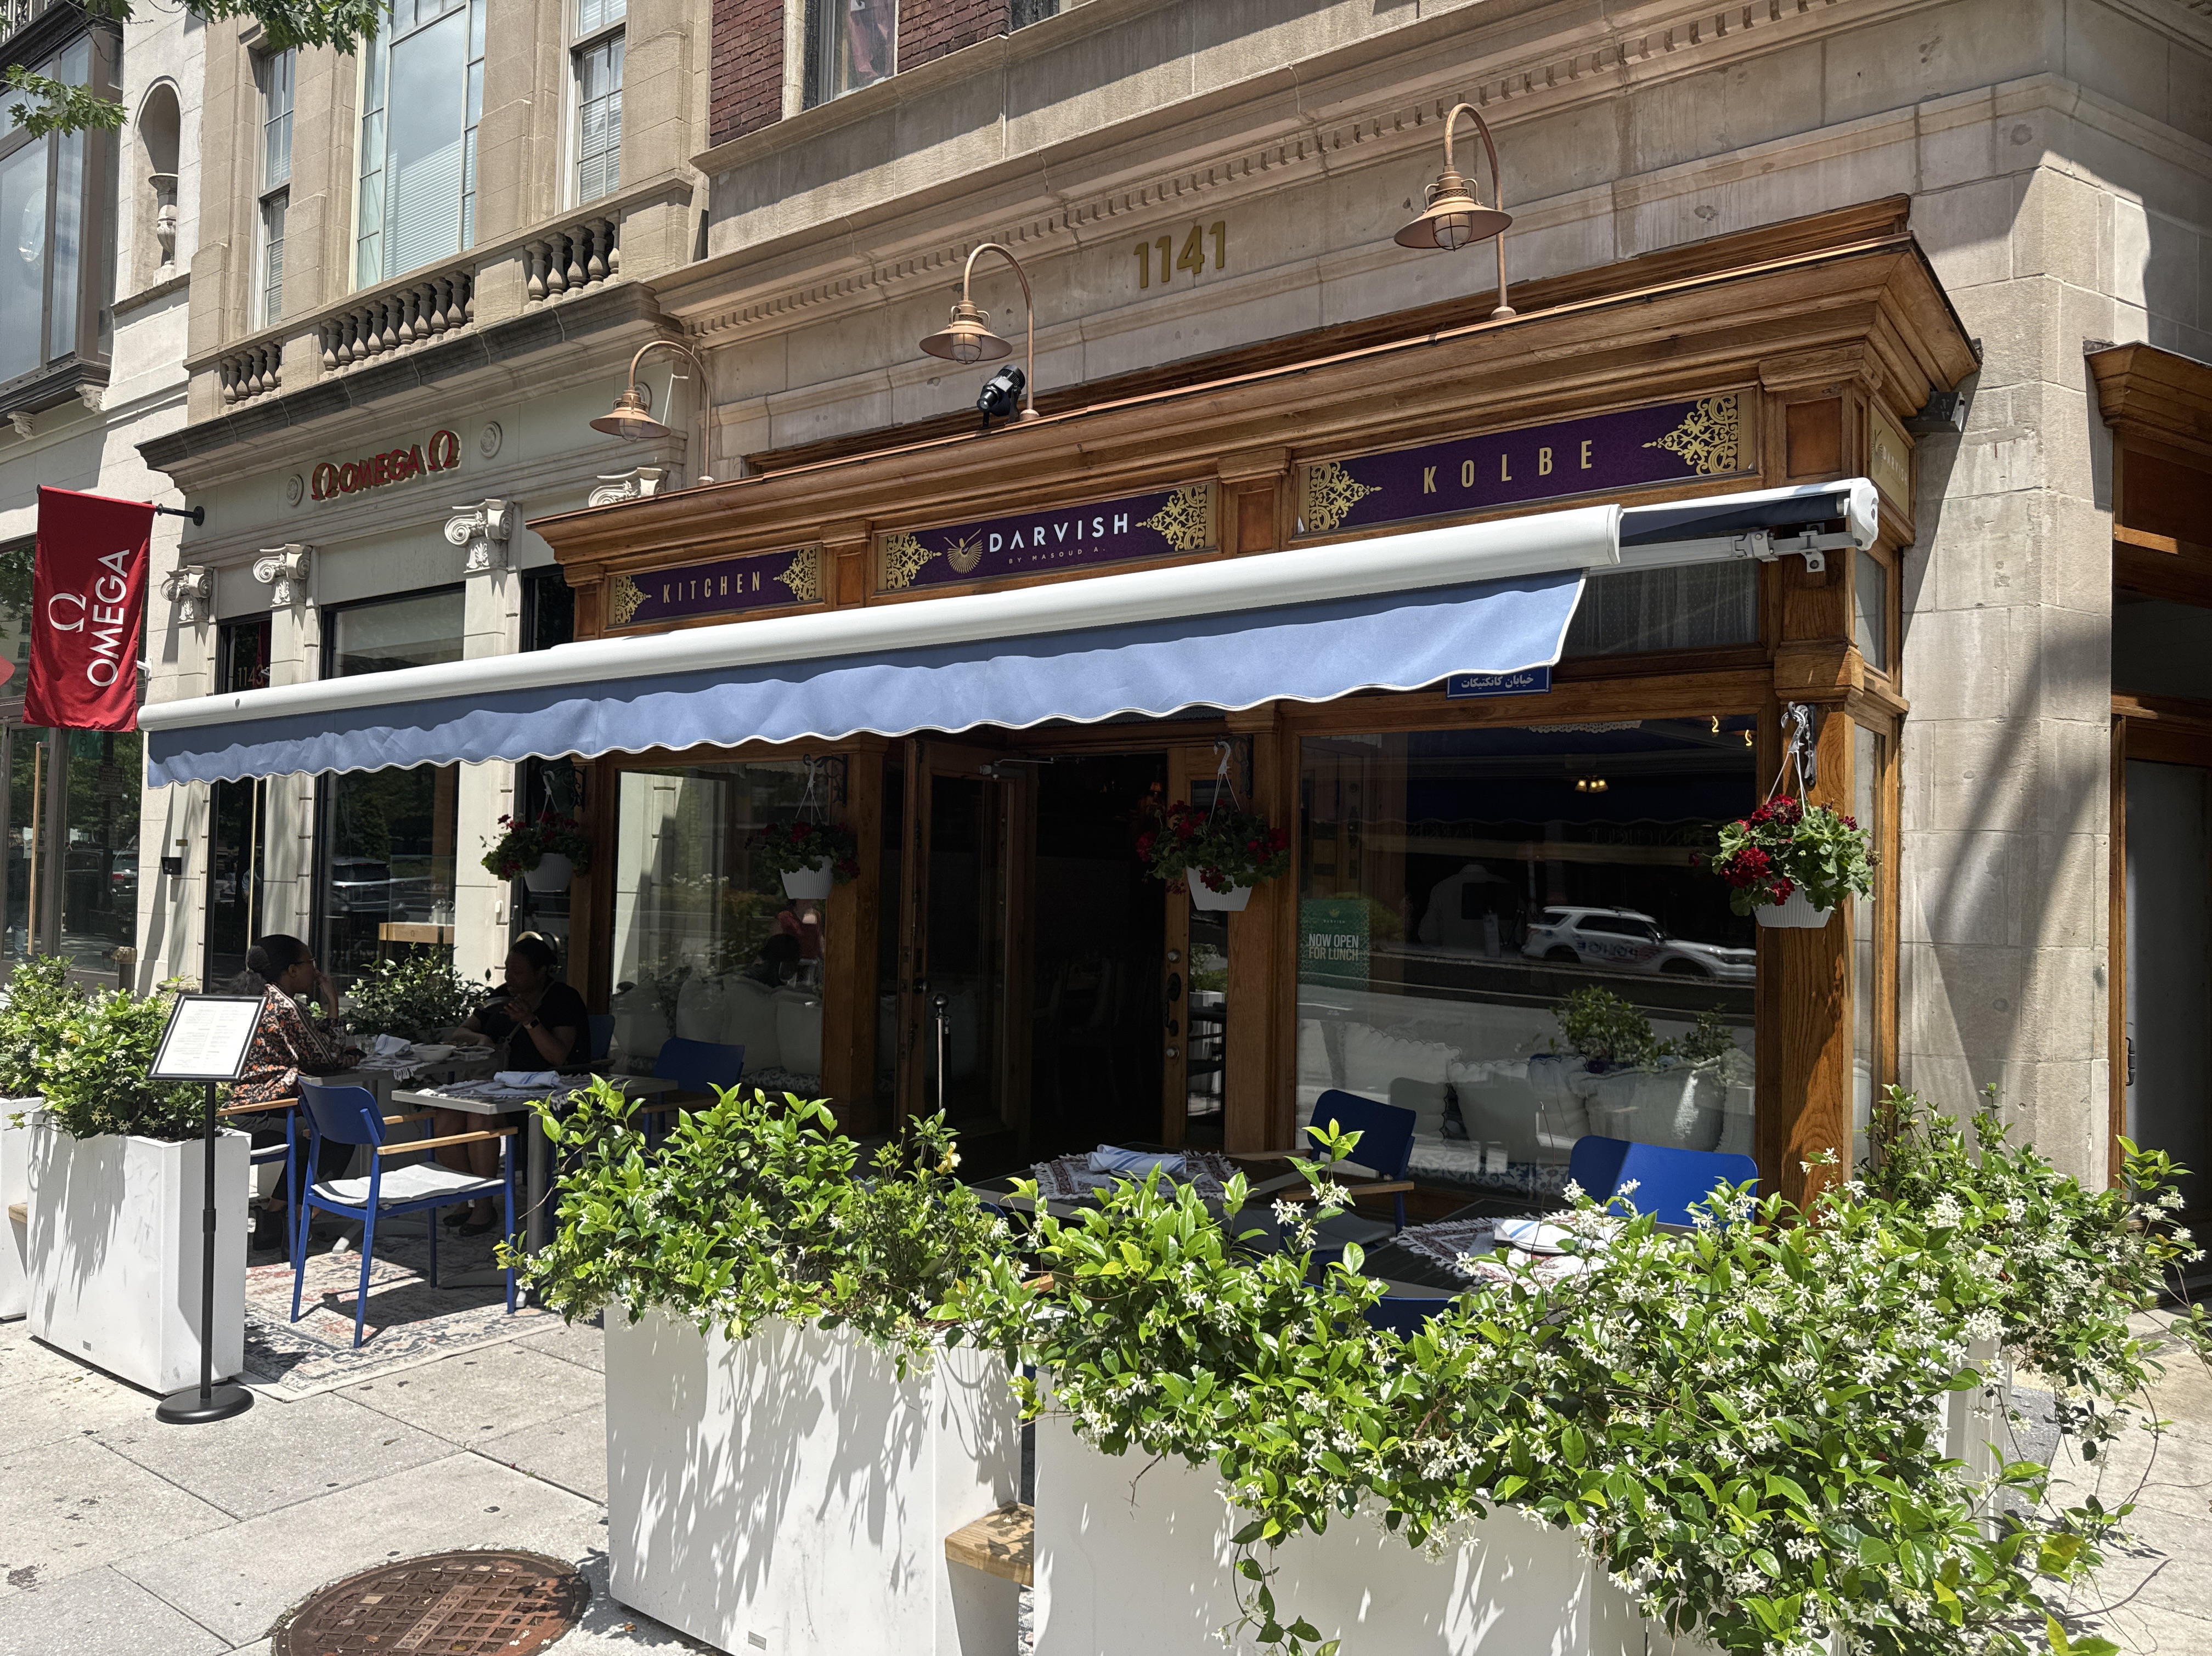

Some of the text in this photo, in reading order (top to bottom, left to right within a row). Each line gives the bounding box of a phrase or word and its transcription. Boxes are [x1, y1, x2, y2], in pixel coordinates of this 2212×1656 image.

[1133, 220, 1226, 289] 1141
[338, 443, 427, 494] OMEGA
[1424, 439, 1593, 494] KOLBE
[989, 513, 1128, 553] DARVISH
[1032, 549, 1083, 561] MASOUD
[663, 571, 760, 603] KITCHEN
[87, 549, 130, 687] OMEGA
[1308, 933, 1359, 948] NOW OPEN
[1308, 946, 1358, 961] FOR LUNCH
